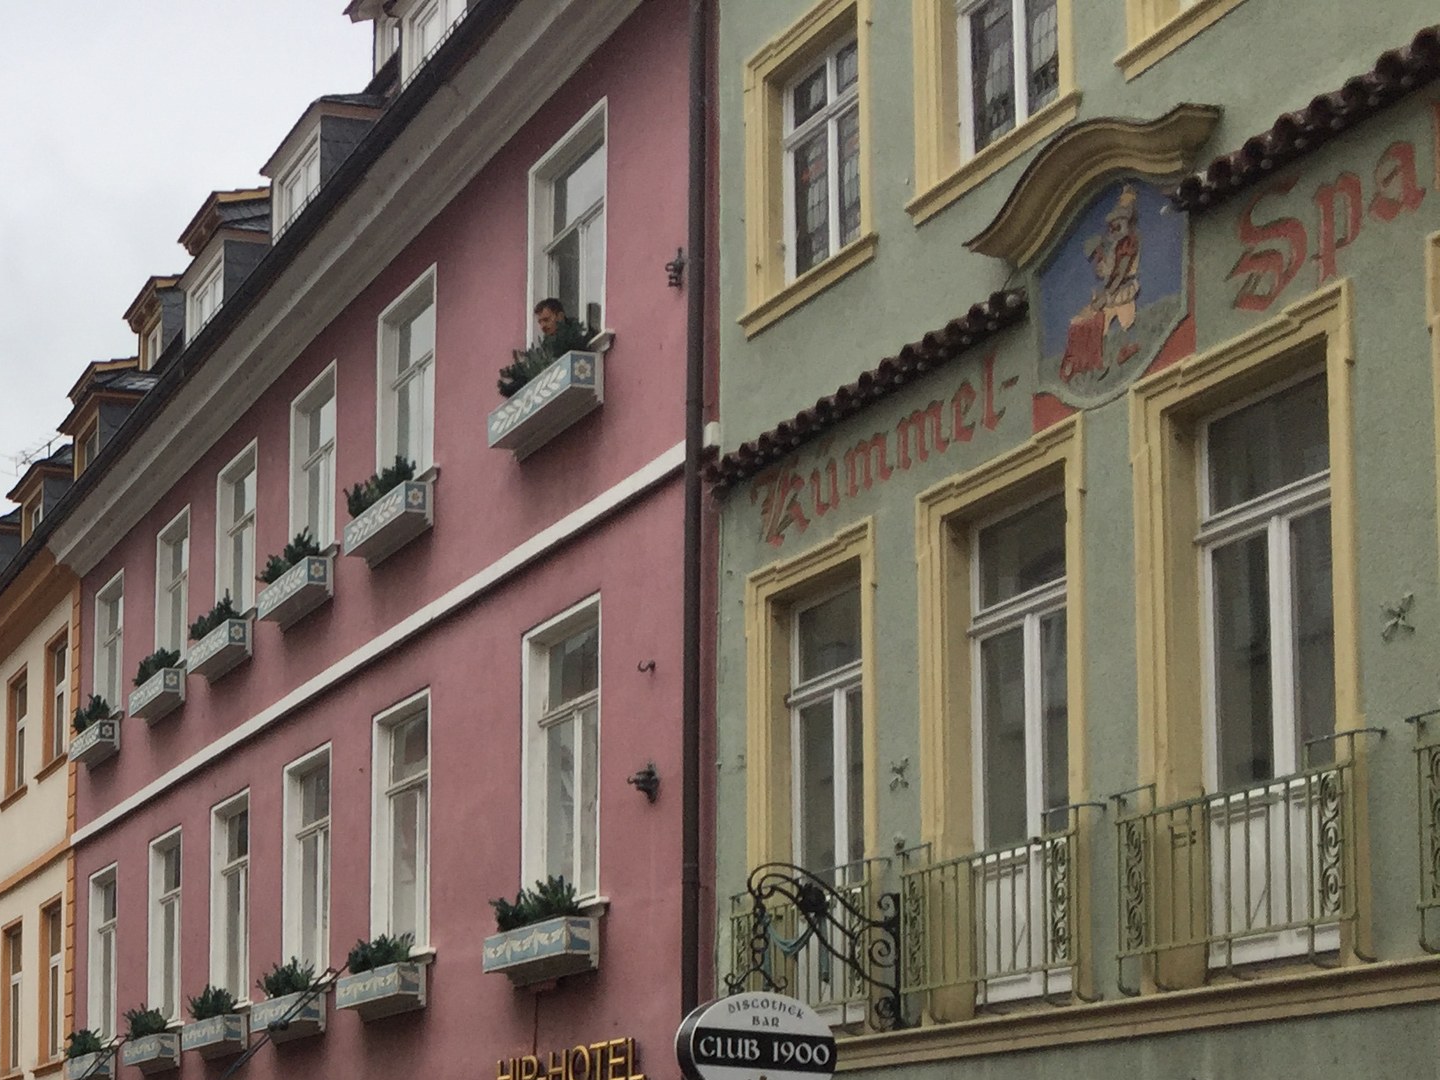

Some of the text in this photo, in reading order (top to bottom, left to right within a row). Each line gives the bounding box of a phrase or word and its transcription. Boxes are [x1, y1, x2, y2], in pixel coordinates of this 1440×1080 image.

[1223, 101, 1440, 313] Spa
[752, 1016, 780, 1028] BAR
[699, 1035, 830, 1066] CLUB 1900
